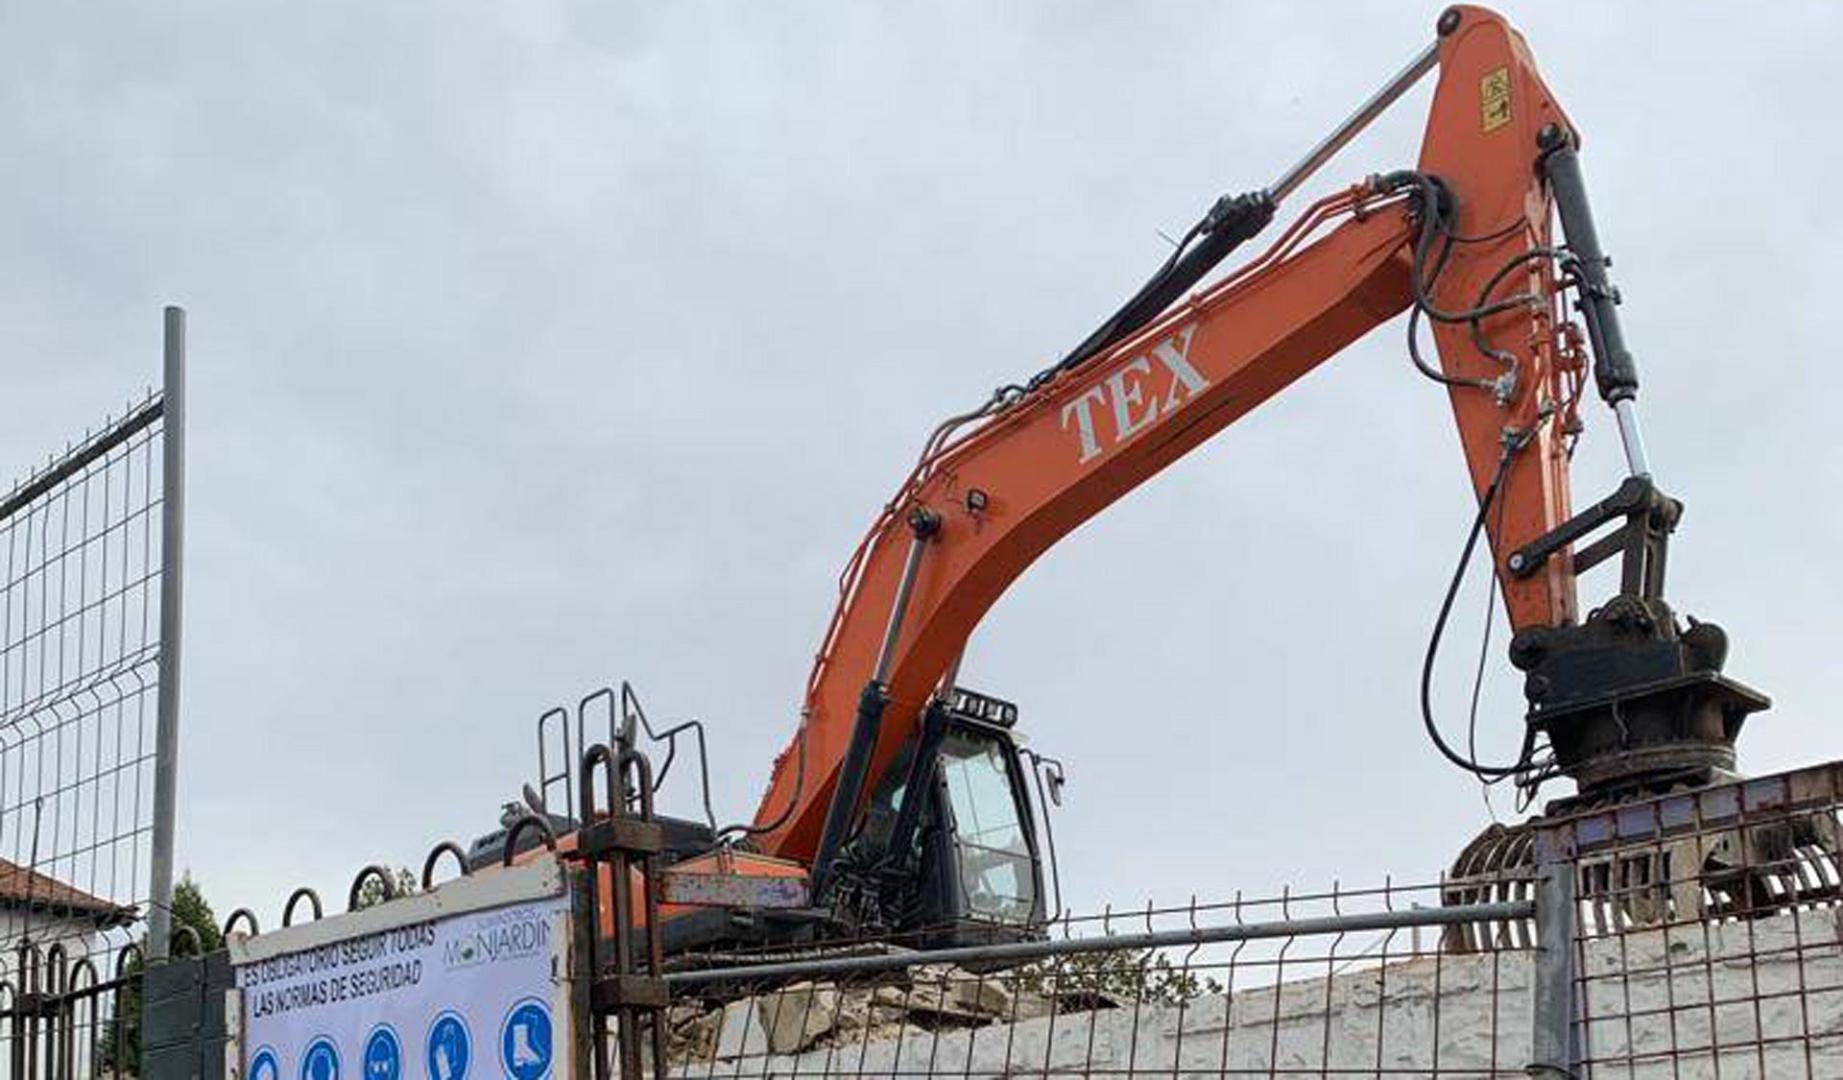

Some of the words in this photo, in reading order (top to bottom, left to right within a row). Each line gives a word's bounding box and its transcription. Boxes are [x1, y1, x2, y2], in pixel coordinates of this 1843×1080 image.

[1060, 323, 1211, 464] TEX
[244, 964, 259, 988] ES
[262, 943, 339, 984] OBLIGATORIO
[341, 934, 387, 965] SEGUIR
[387, 920, 436, 955] TODAS
[254, 991, 274, 1018] LAS
[276, 980, 327, 1013] NORMAS
[331, 977, 347, 1002] DE
[351, 960, 423, 998] SEGURIDAD
